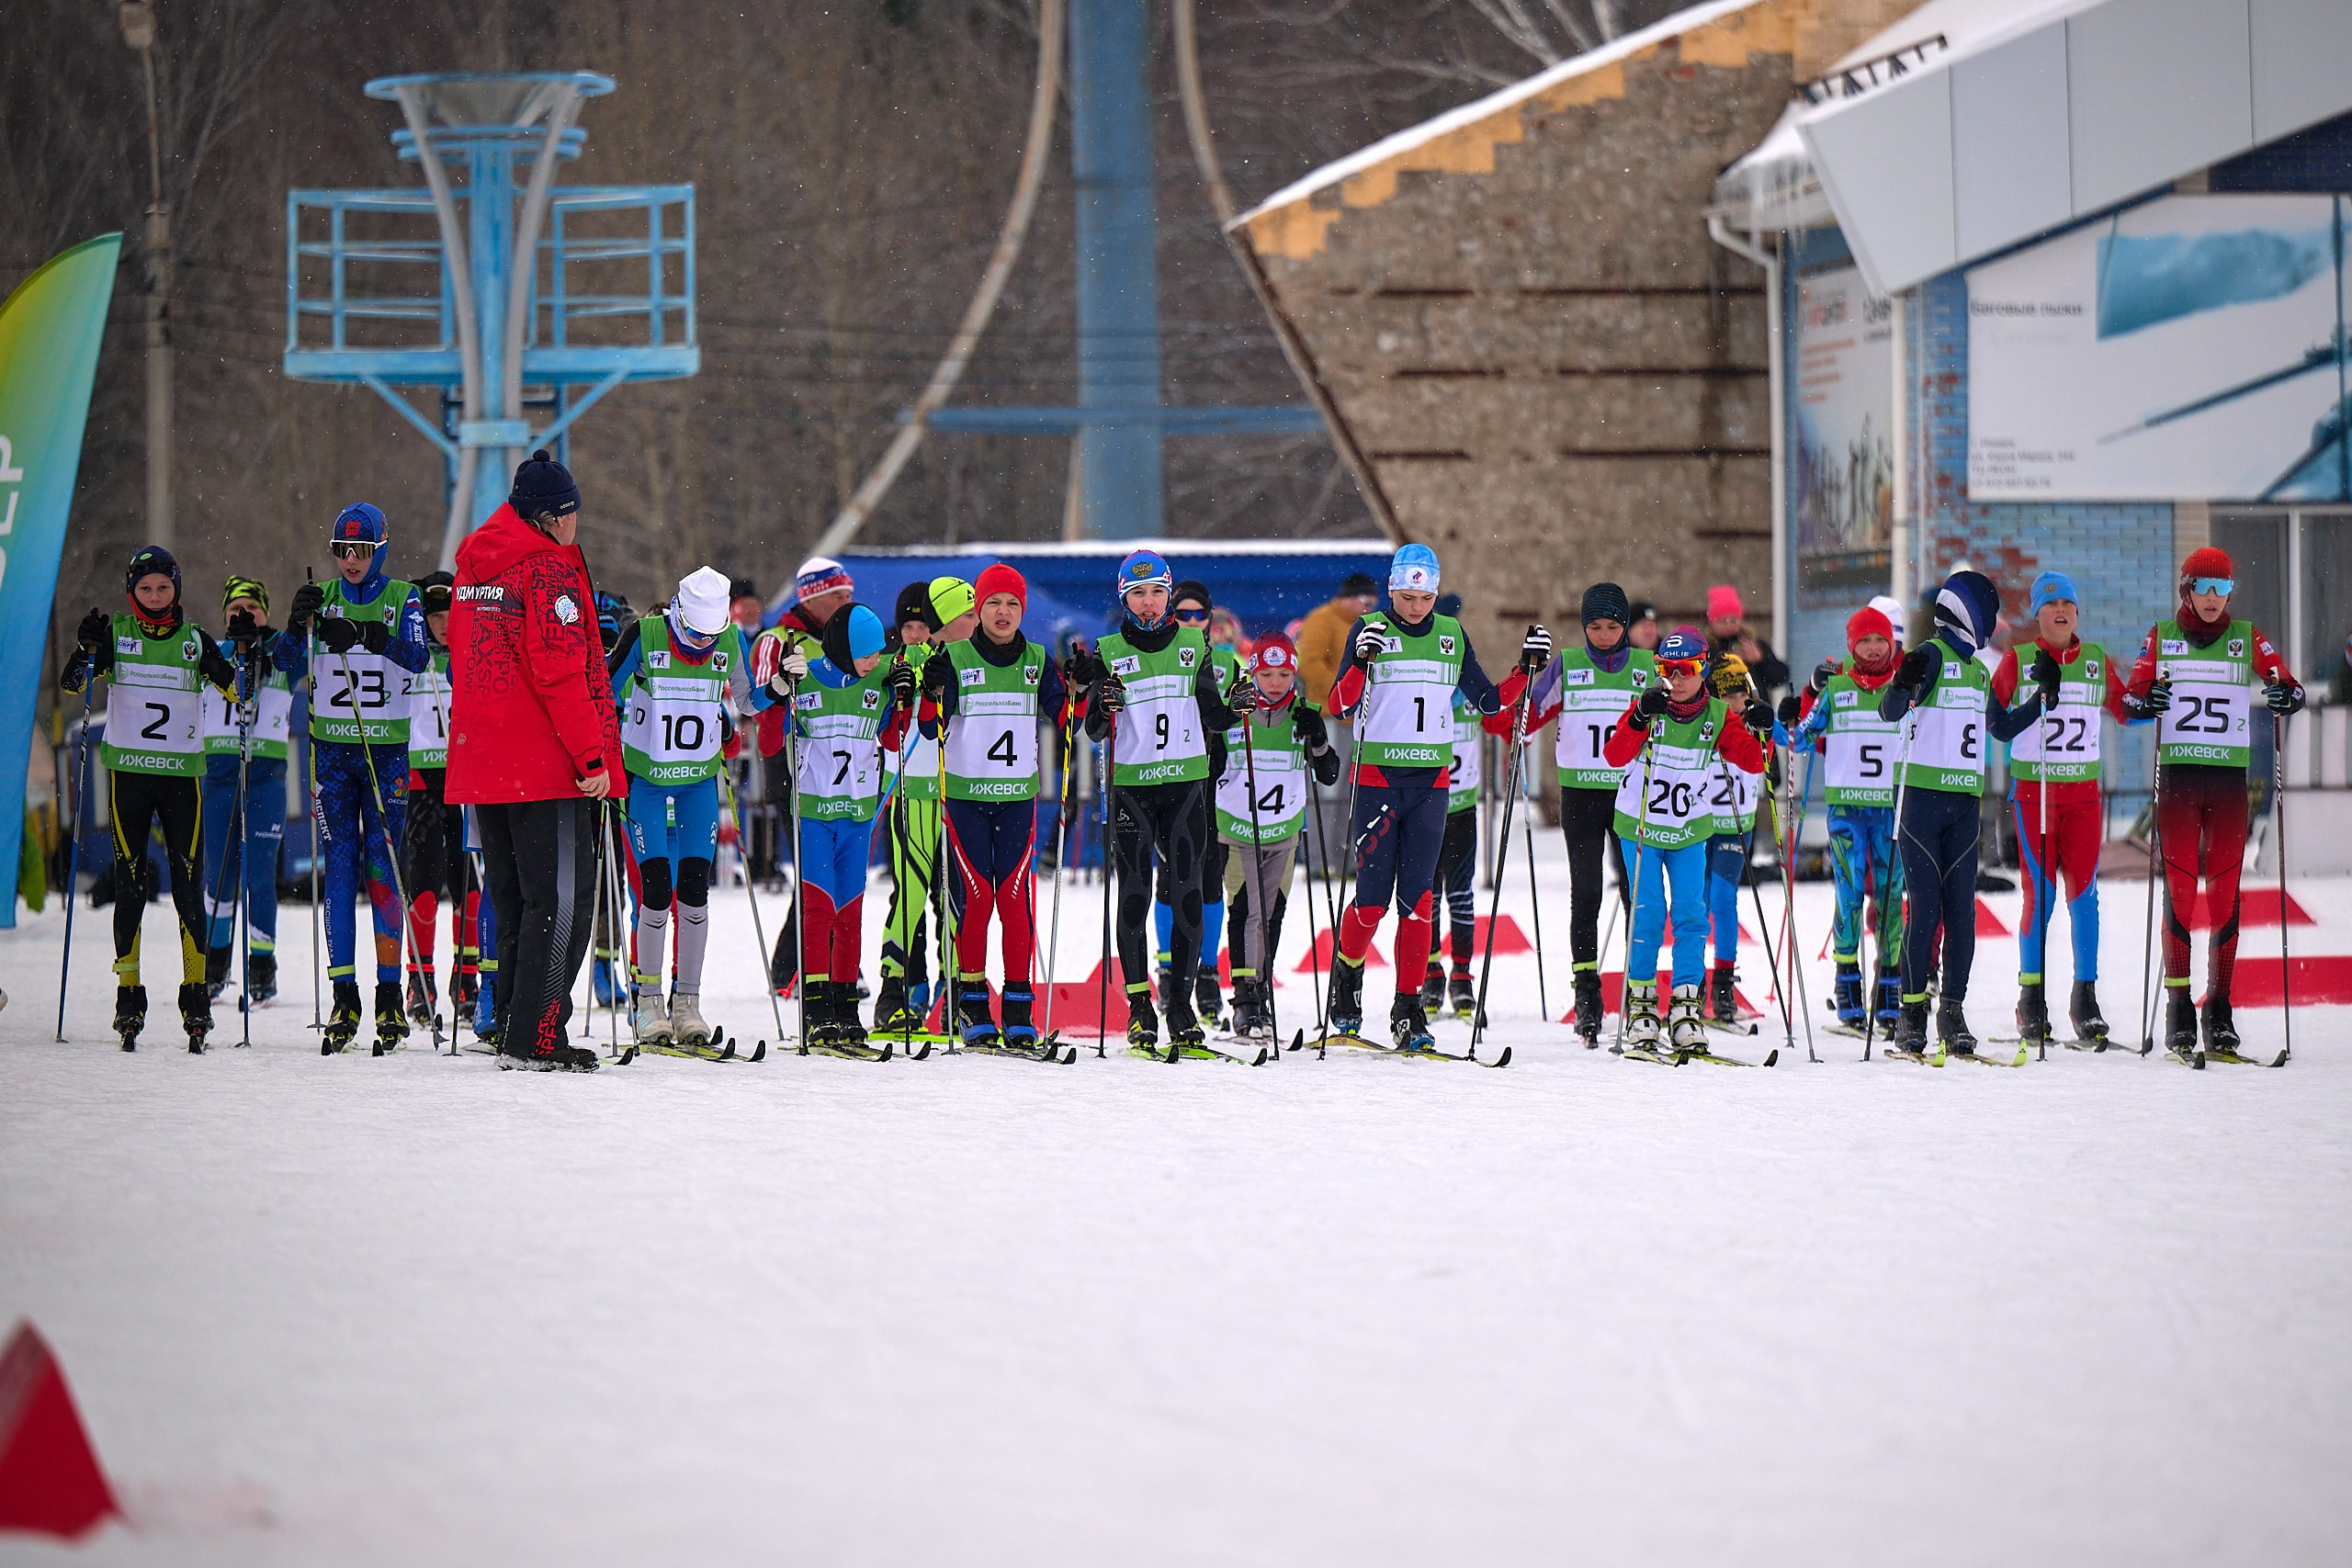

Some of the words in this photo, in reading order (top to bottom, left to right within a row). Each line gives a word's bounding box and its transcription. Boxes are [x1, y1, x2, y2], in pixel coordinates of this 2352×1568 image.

[456, 585, 504, 602] УДМУРТИЯ
[130, 671, 178, 682] РоссельхозБанк
[331, 670, 385, 707] 23
[384, 691, 392, 704] 2
[141, 703, 170, 741] 2
[273, 716, 281, 728] 2
[433, 706, 452, 738] 1
[1414, 696, 1425, 732] 1
[1441, 716, 1445, 728] 2
[2175, 696, 2230, 733] 25
[2237, 718, 2245, 731] 2
[187, 726, 196, 739] 2
[662, 715, 704, 750] 10
[1156, 713, 1170, 750] 9
[1183, 729, 1191, 742] 2
[2045, 717, 2086, 751] 22
[210, 737, 266, 751] ИЖЕСК
[987, 729, 1018, 767] 4
[832, 750, 852, 785] 7
[1138, 764, 1185, 781] ИЖВСК
[1860, 745, 1883, 777] 5
[856, 771, 866, 783] 2
[1577, 771, 1624, 783] ИЖЕВ
[1245, 782, 1285, 815] 14
[1648, 779, 1690, 818] 20
[1689, 794, 1697, 807] 2
